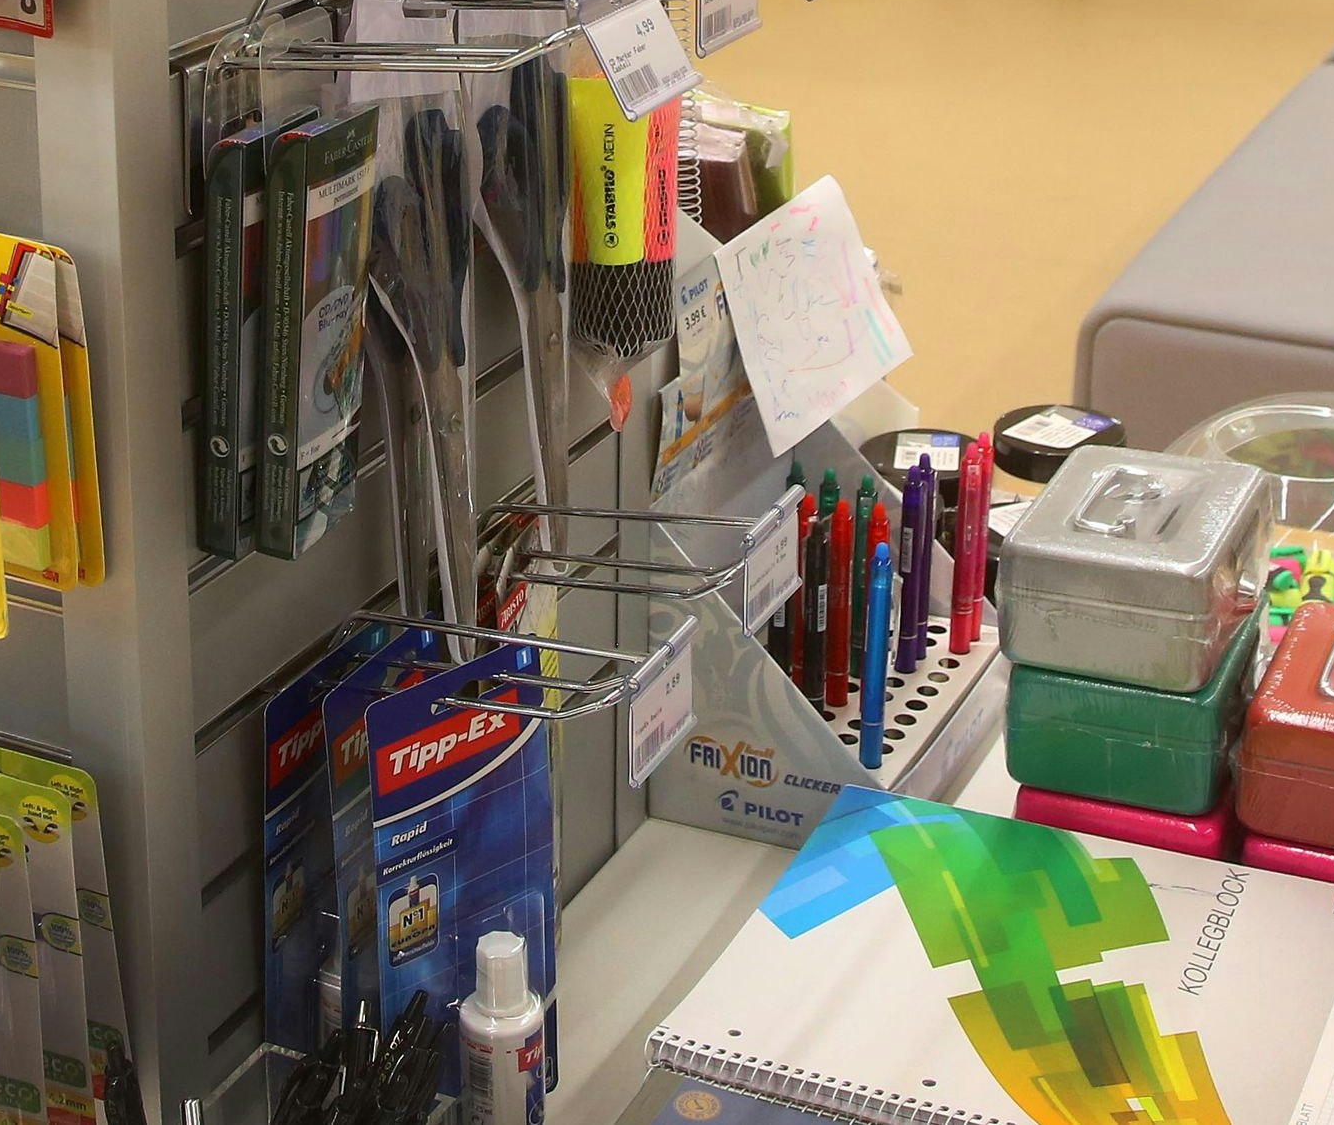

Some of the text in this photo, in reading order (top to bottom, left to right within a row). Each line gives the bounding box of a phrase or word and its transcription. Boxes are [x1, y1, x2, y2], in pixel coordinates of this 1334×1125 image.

[634, 18, 656, 37] 4,99
[603, 122, 618, 230] STABILO NEON
[688, 278, 709, 300] PILOT
[318, 293, 351, 320] CD/DVD
[684, 305, 708, 331] 3,99 €
[318, 309, 350, 333] Blu-ray
[501, 588, 525, 629] ARISTO
[521, 649, 528, 664] 1
[389, 712, 506, 777] Tipp-Ex
[784, 774, 842, 795] CLICKER
[21, 801, 37, 813] Left-
[43, 806, 59, 819] Right
[27, 809, 54, 822] hand use
[744, 801, 804, 828] PILOT
[391, 820, 429, 848] Rapid
[382, 837, 455, 877] Korrekturflüssigkeit
[1177, 870, 1252, 996] KOLLEGBLOCK
[1295, 1102, 1315, 1125] BLATT
